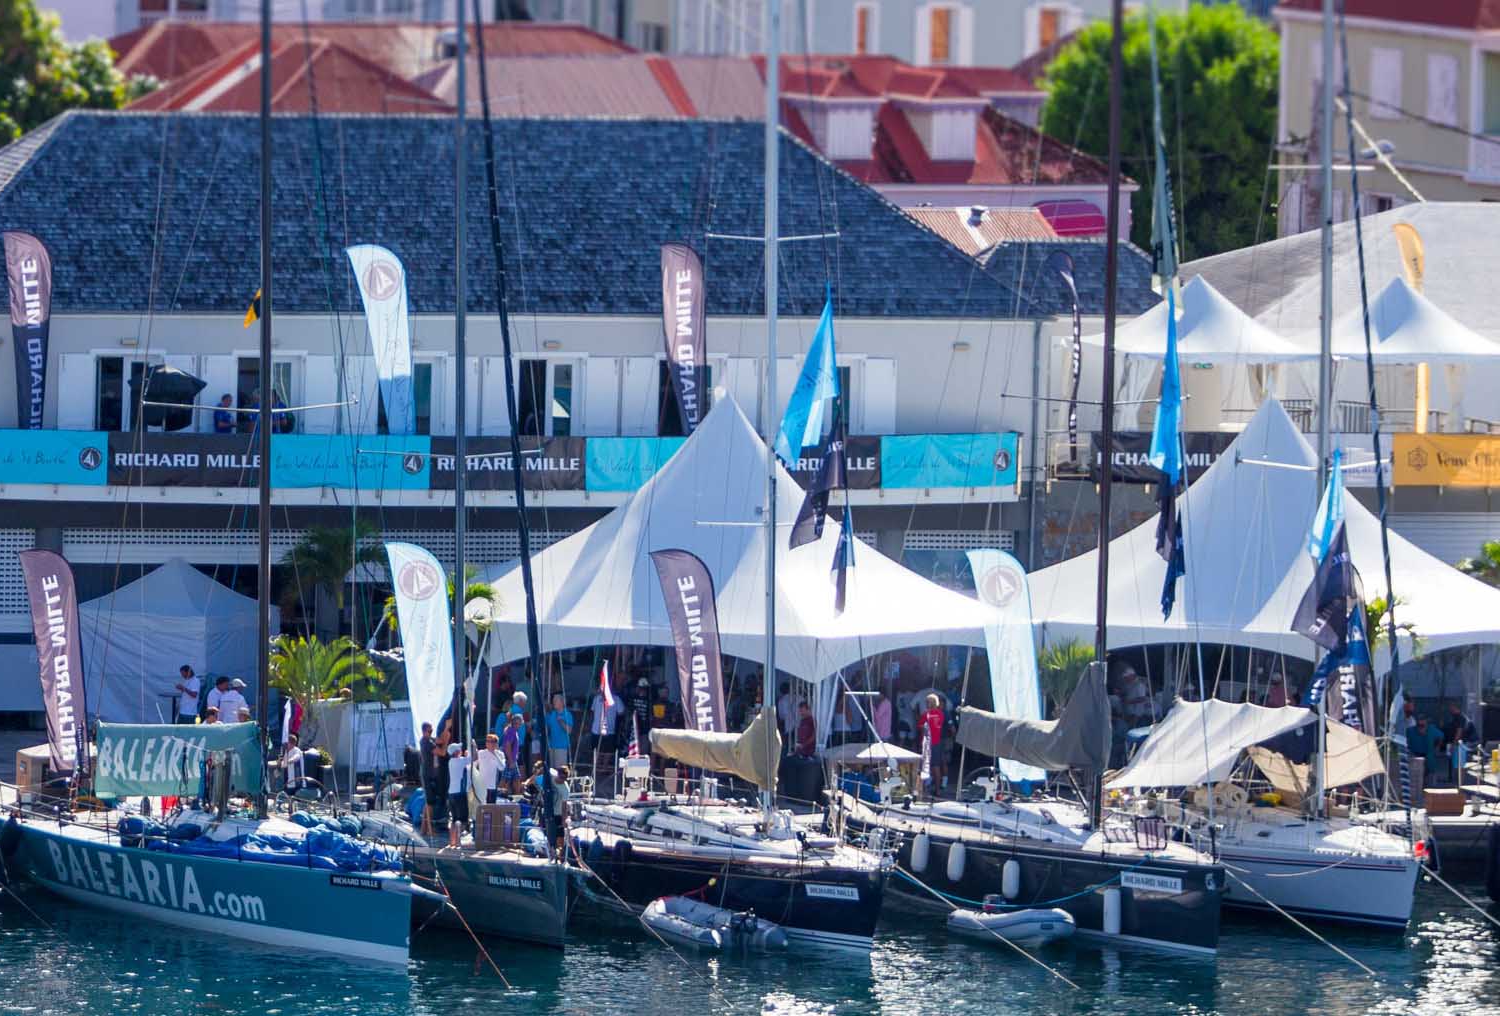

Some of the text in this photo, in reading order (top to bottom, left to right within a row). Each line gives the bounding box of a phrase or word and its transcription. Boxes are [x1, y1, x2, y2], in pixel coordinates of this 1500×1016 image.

[115, 452, 261, 468] RICHARD MILLE
[437, 457, 515, 471] RIHARD
[526, 457, 580, 471] MILLE
[333, 876, 379, 888] RICHARD MILLE
[489, 875, 541, 889] RICHARD MILLE
